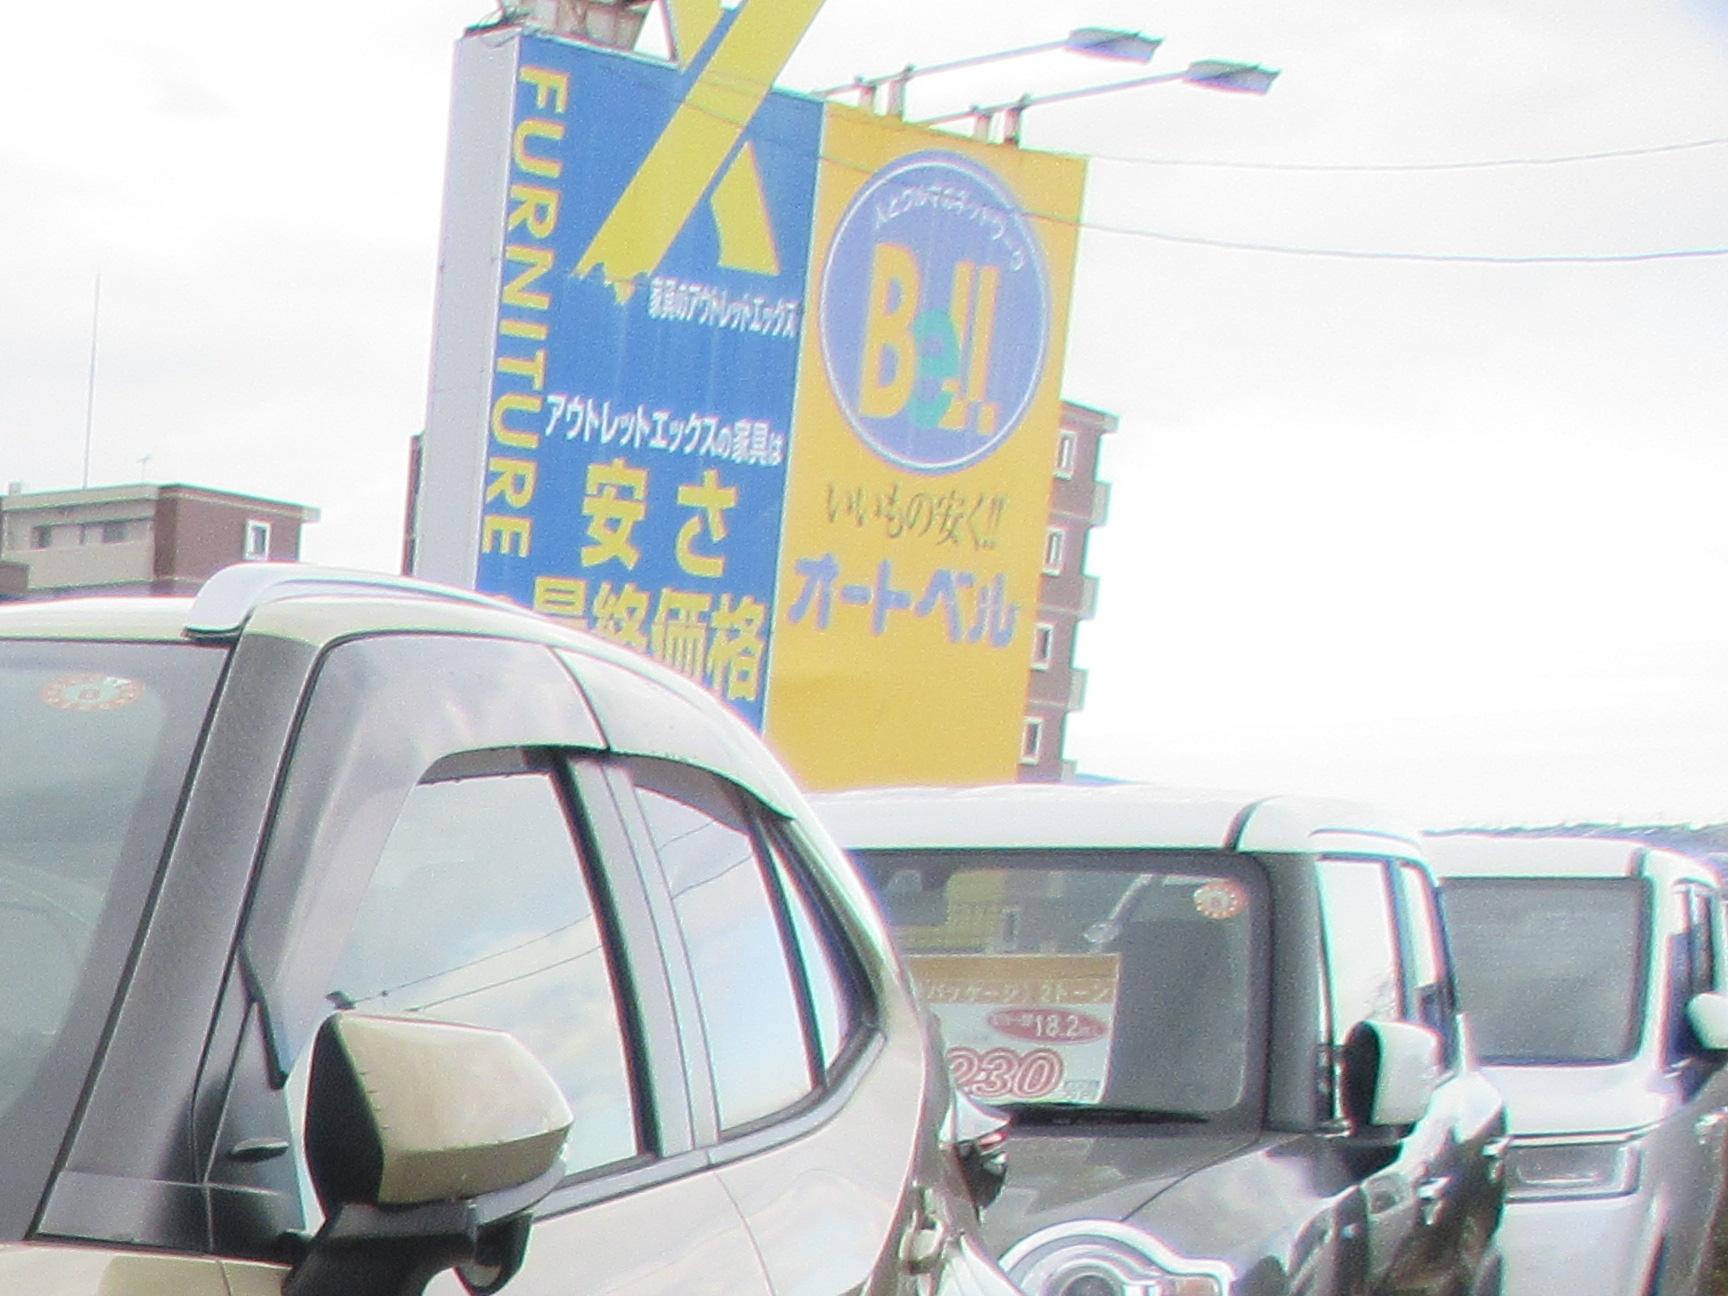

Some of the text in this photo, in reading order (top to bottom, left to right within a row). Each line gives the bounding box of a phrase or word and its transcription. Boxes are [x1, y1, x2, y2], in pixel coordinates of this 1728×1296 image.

[482, 63, 570, 560] FURNITURE
[545, 393, 785, 466] アウトレットエックスの家具は
[580, 457, 741, 577] 安さ
[790, 552, 1020, 646] オートベル
